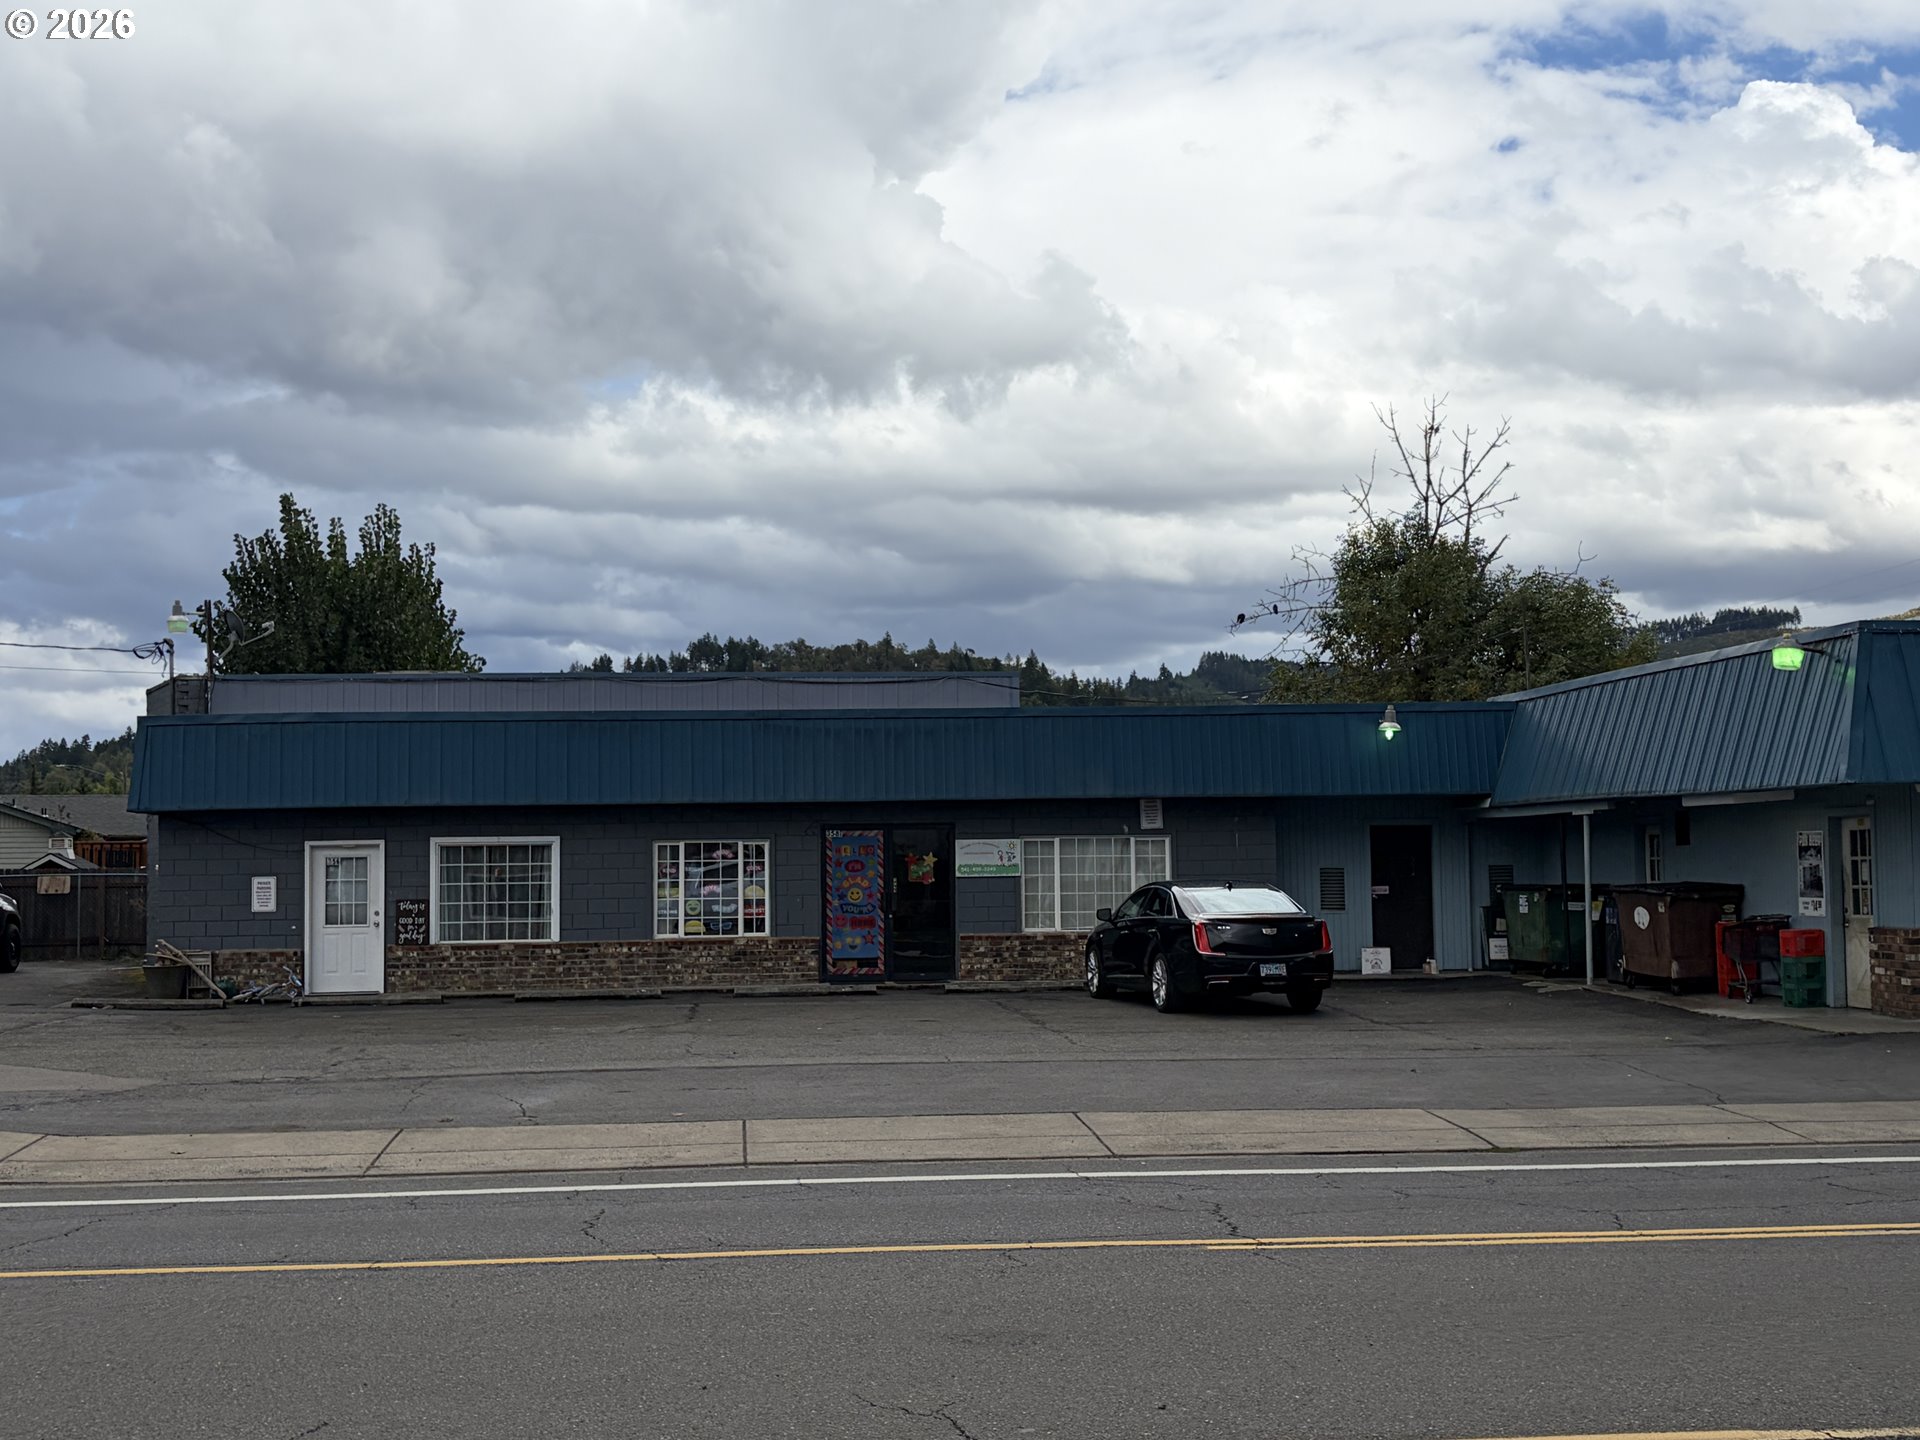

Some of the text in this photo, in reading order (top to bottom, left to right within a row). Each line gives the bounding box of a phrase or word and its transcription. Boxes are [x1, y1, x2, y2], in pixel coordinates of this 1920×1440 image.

[834, 844, 876, 857] HELLO
[843, 876, 870, 888] GLAD
[398, 900, 418, 913] today
[842, 903, 874, 914] YOU'RE
